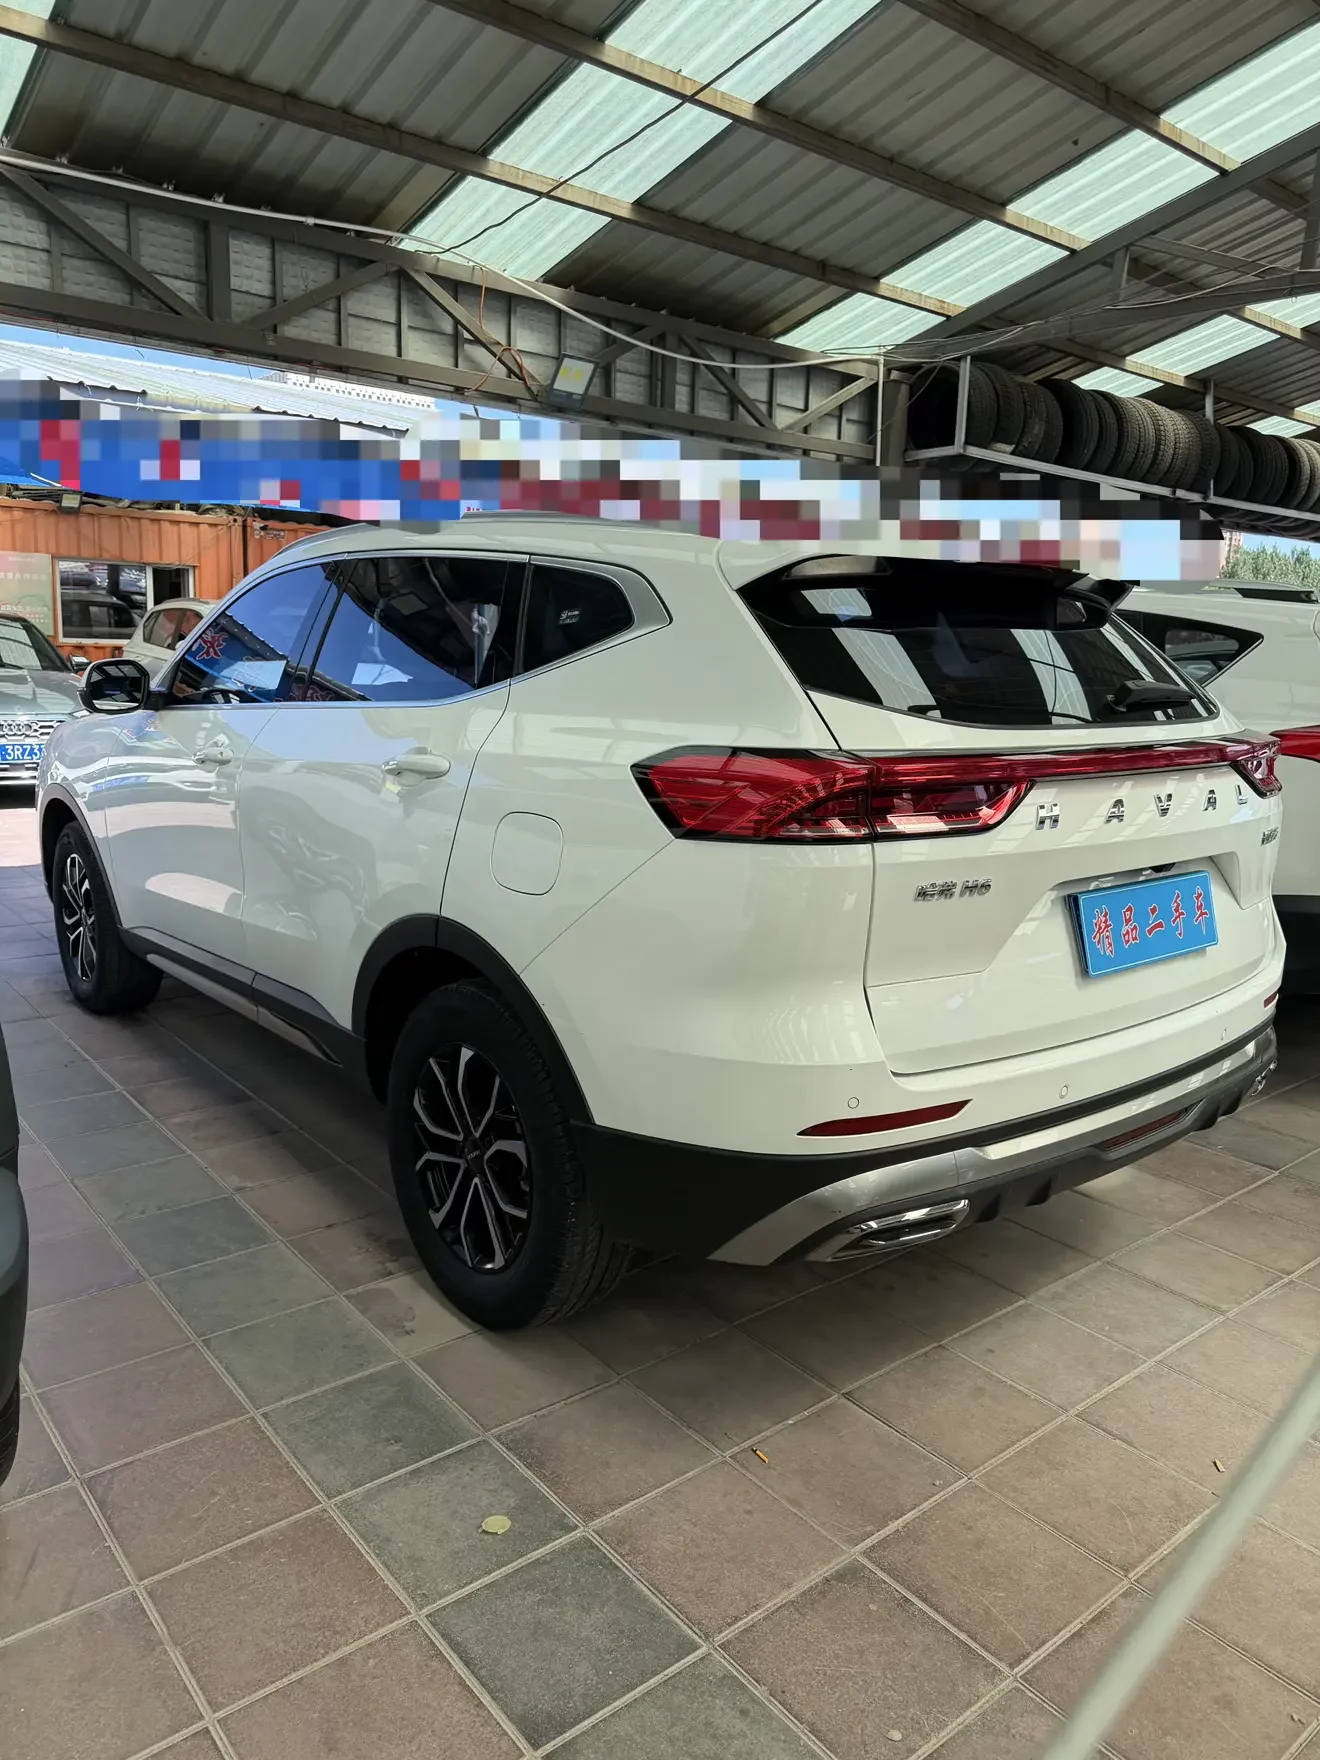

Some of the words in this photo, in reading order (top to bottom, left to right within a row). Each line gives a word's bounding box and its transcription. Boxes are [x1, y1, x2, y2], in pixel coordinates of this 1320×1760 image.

[1035, 784, 1249, 831] HAVAL
[959, 877, 992, 898] H6
[1092, 885, 1209, 958] 精品二手车
